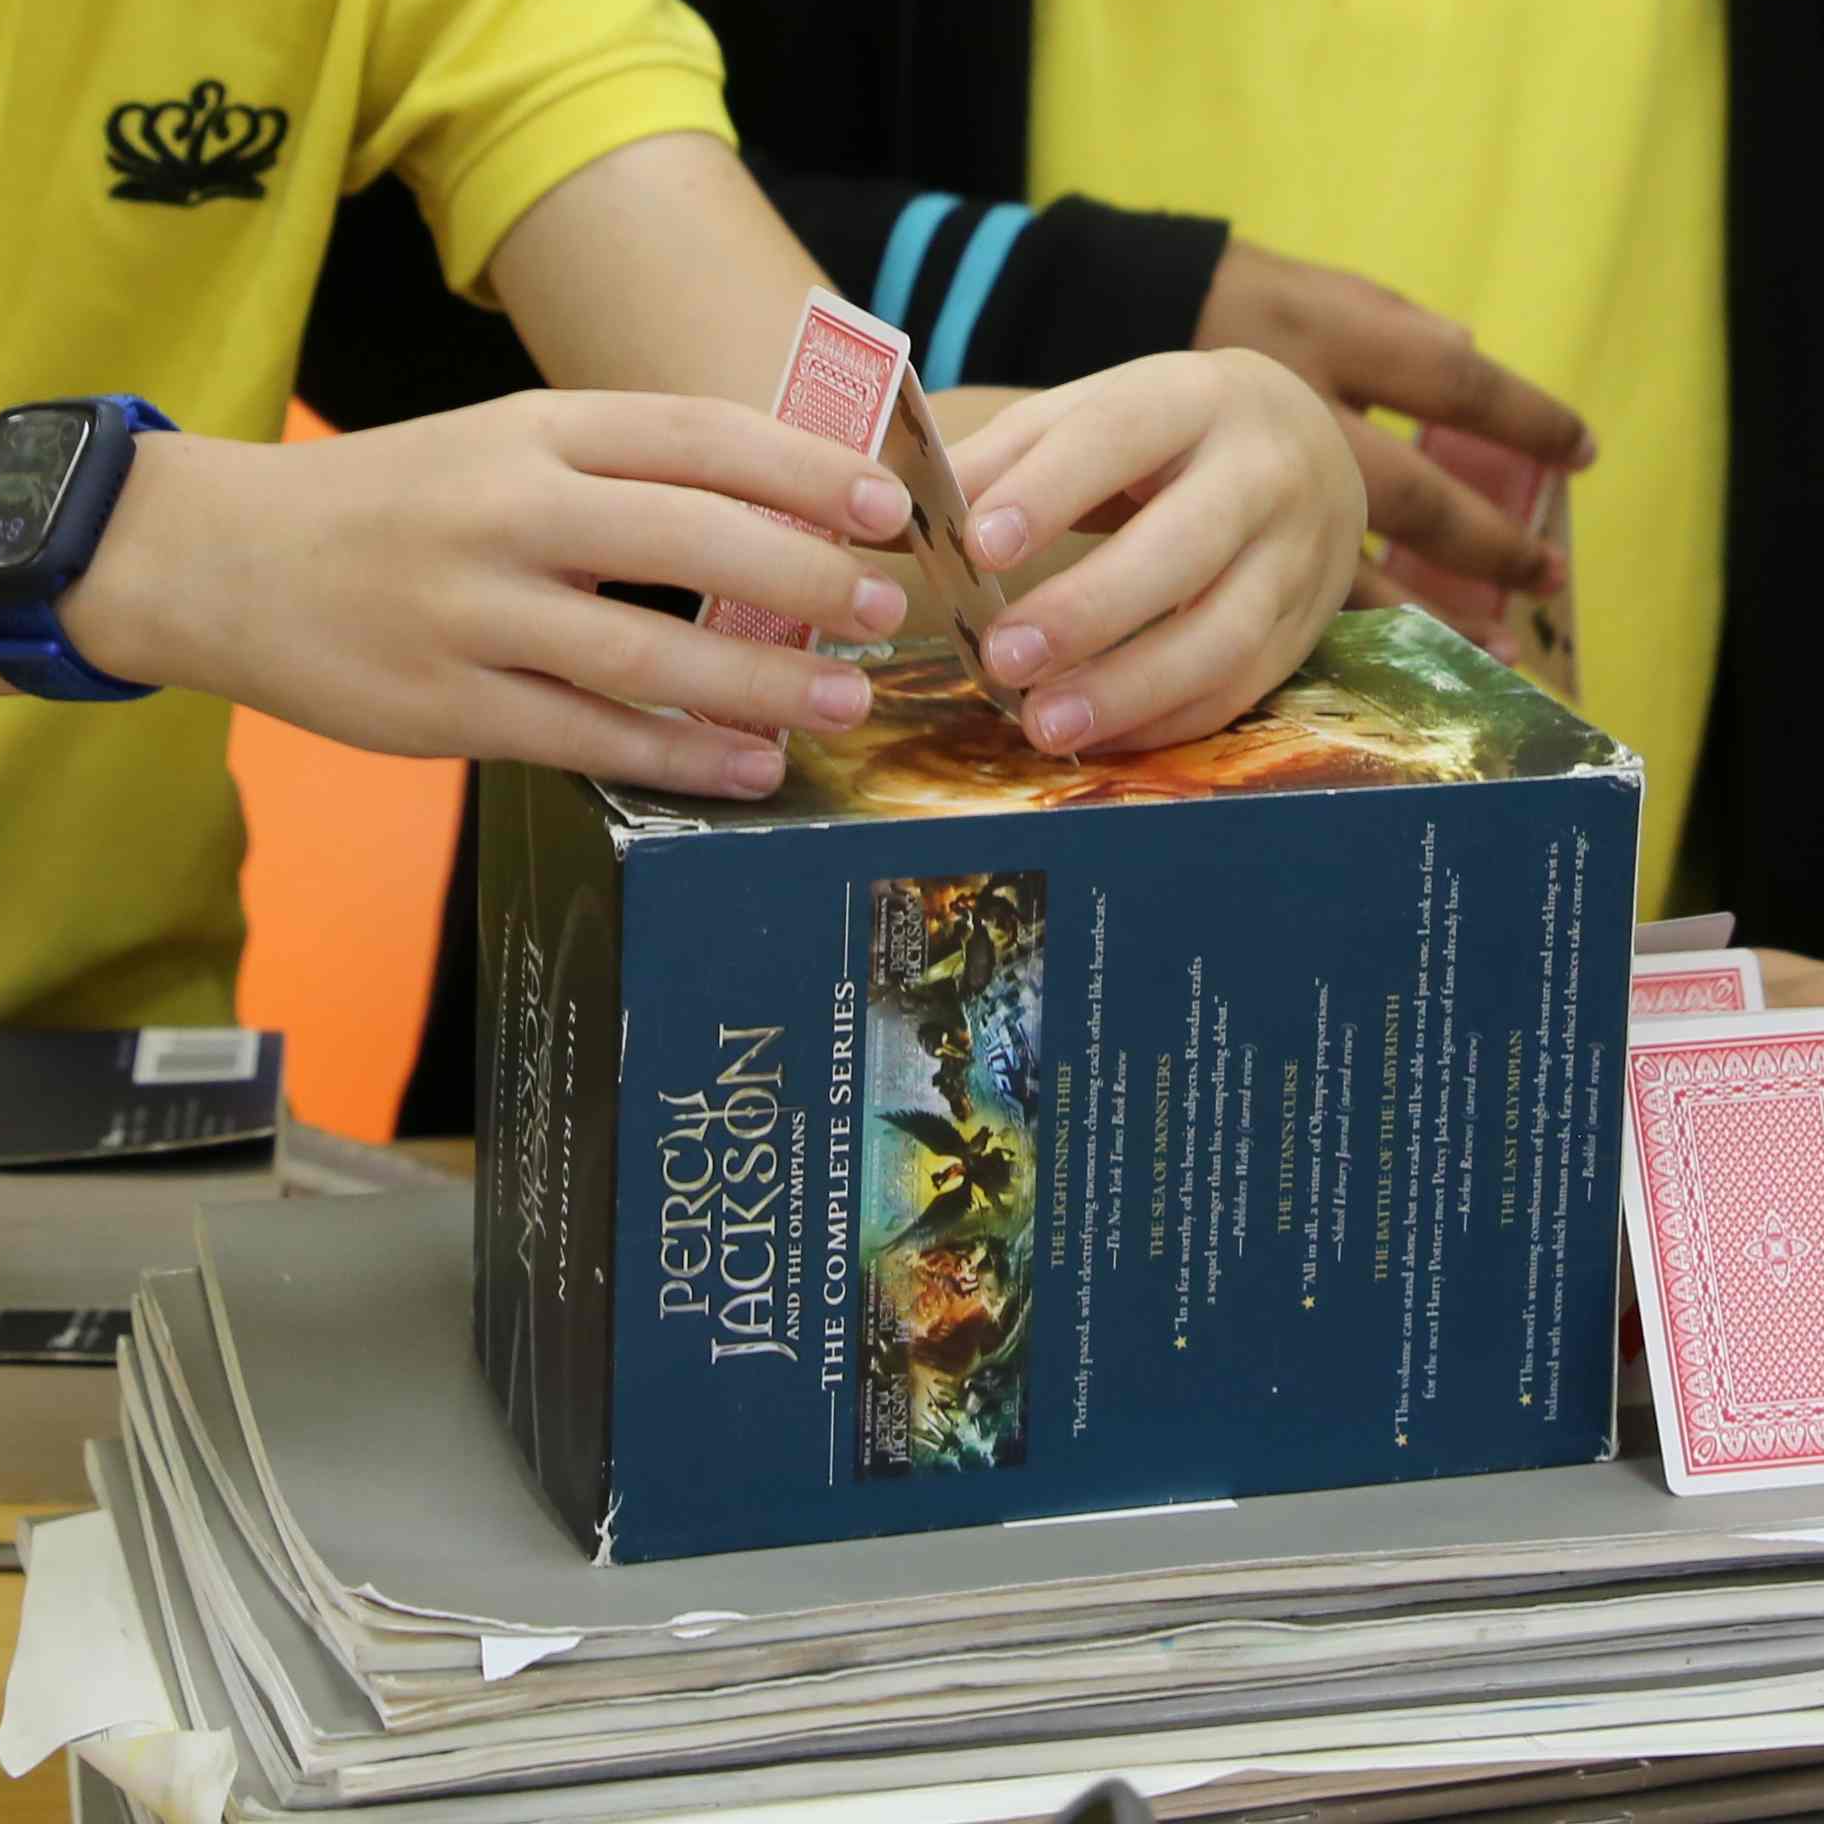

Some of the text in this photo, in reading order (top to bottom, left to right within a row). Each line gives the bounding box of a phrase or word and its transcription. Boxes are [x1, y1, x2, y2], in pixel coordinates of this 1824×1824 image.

[1418, 820, 1435, 872] further
[1546, 842, 1558, 854] is
[1422, 874, 1432, 893] no
[1545, 857, 1557, 879] wit
[1539, 882, 1561, 947] crackling
[1570, 872, 1583, 915] center
[1415, 897, 1431, 934] Look
[1441, 911, 1461, 962] already
[1566, 918, 1581, 948] take
[1186, 955, 1202, 997] crafts
[1415, 970, 1431, 996] just
[1439, 964, 1455, 995] fans
[1538, 949, 1553, 976] and
[1562, 950, 1579, 1002] choices
[1087, 971, 1103, 1000] like
[1439, 997, 1453, 1014] of
[1085, 1001, 1101, 1041] other
[1184, 999, 1200, 1059] Riordan
[1411, 999, 1426, 1029] read
[1534, 980, 1551, 1047] adventure
[1560, 1003, 1577, 1051] ethical
[1084, 1042, 1100, 1076] each
[1413, 1032, 1425, 1048] to
[1436, 1015, 1457, 1065] legions
[1111, 1049, 1127, 1094] Review
[1409, 1052, 1424, 1079] able
[1440, 1067, 1450, 1083] as
[1559, 1052, 1574, 1080] and
[518, 920, 545, 1278] JACKSON
[1082, 1076, 1103, 1132] chasing
[1208, 1047, 1230, 1127] compelling
[1281, 1057, 1298, 1119] CURSE
[1307, 1071, 1329, 1135] Olympic
[1408, 1083, 1422, 1099] be
[1530, 1049, 1553, 1134] high-voltage
[533, 1002, 554, 1239] PERCY
[1110, 1094, 1125, 1127] Book
[1406, 1102, 1422, 1129] will
[1500, 1028, 1523, 1226] THE LAST OLYMPIAN
[558, 999, 577, 1302] RICK RIORDAN
[1109, 1127, 1124, 1164] Times
[1149, 1053, 1171, 1257] THE SEA OF MONSTERS
[1179, 1123, 1195, 1168] heroic
[1207, 1128, 1222, 1151] his
[1234, 1134, 1253, 1177] Weekly
[1307, 1136, 1321, 1153] of
[1334, 1112, 1353, 1159] Journal
[1373, 992, 1400, 1280] THE BATTLE OF THE LABYRINTH
[1404, 1133, 1420, 1175] reader
[1458, 1122, 1474, 1171] Reviews
[1530, 1137, 1544, 1152] of
[1581, 1132, 1596, 1178] Booklist
[1050, 1060, 1072, 1267] THE LIGHTNING THIEF
[1083, 1133, 1096, 1199] moments
[1108, 1165, 1123, 1195] York
[1178, 1169, 1193, 1192] his
[1206, 1153, 1221, 1187] than
[1307, 1154, 1320, 1204] winner
[1332, 1159, 1351, 1206] Library
[1431, 1146, 1451, 1184] Percy
[653, 1083, 723, 1321] PERCY
[710, 1016, 803, 1370] JACKSON
[820, 979, 856, 1391] THE COMPLETE SERIES
[1178, 1194, 1192, 1211] of
[1408, 1178, 1418, 1196] no
[1433, 1187, 1444, 1220] meet
[1525, 1154, 1543, 1241] combination
[1552, 1166, 1568, 1216] human
[785, 1110, 807, 1341] AND THE OLYMPIANS
[1107, 1195, 1121, 1226] New
[1207, 1188, 1225, 1247] stronger
[1277, 1193, 1292, 1233] THE
[1309, 1206, 1318, 1216] a
[1402, 1201, 1417, 1224] but
[1076, 1199, 1099, 1283] electrifying
[1175, 1213, 1196, 1263] worthy
[1305, 1242, 1317, 1259] in
[1550, 1218, 1566, 1260] which
[1174, 1266, 1190, 1293] feat
[1202, 1248, 1222, 1293] sequel
[1399, 1270, 1414, 1308] stand
[1526, 1241, 1544, 1301] winning
[1553, 1262, 1564, 1278] in
[1075, 1284, 1091, 1318] with
[1179, 1294, 1188, 1304] a
[1206, 1295, 1215, 1304] a
[1425, 1274, 1445, 1317] Harry
[1552, 1280, 1563, 1322] scenes
[1402, 1312, 1412, 1336] can
[1427, 1319, 1438, 1350] next
[1545, 1325, 1561, 1357] with
[1395, 1341, 1411, 1389] volume
[1422, 1353, 1437, 1376] the
[1421, 1378, 1436, 1400] for
[1542, 1359, 1559, 1421] balanced
